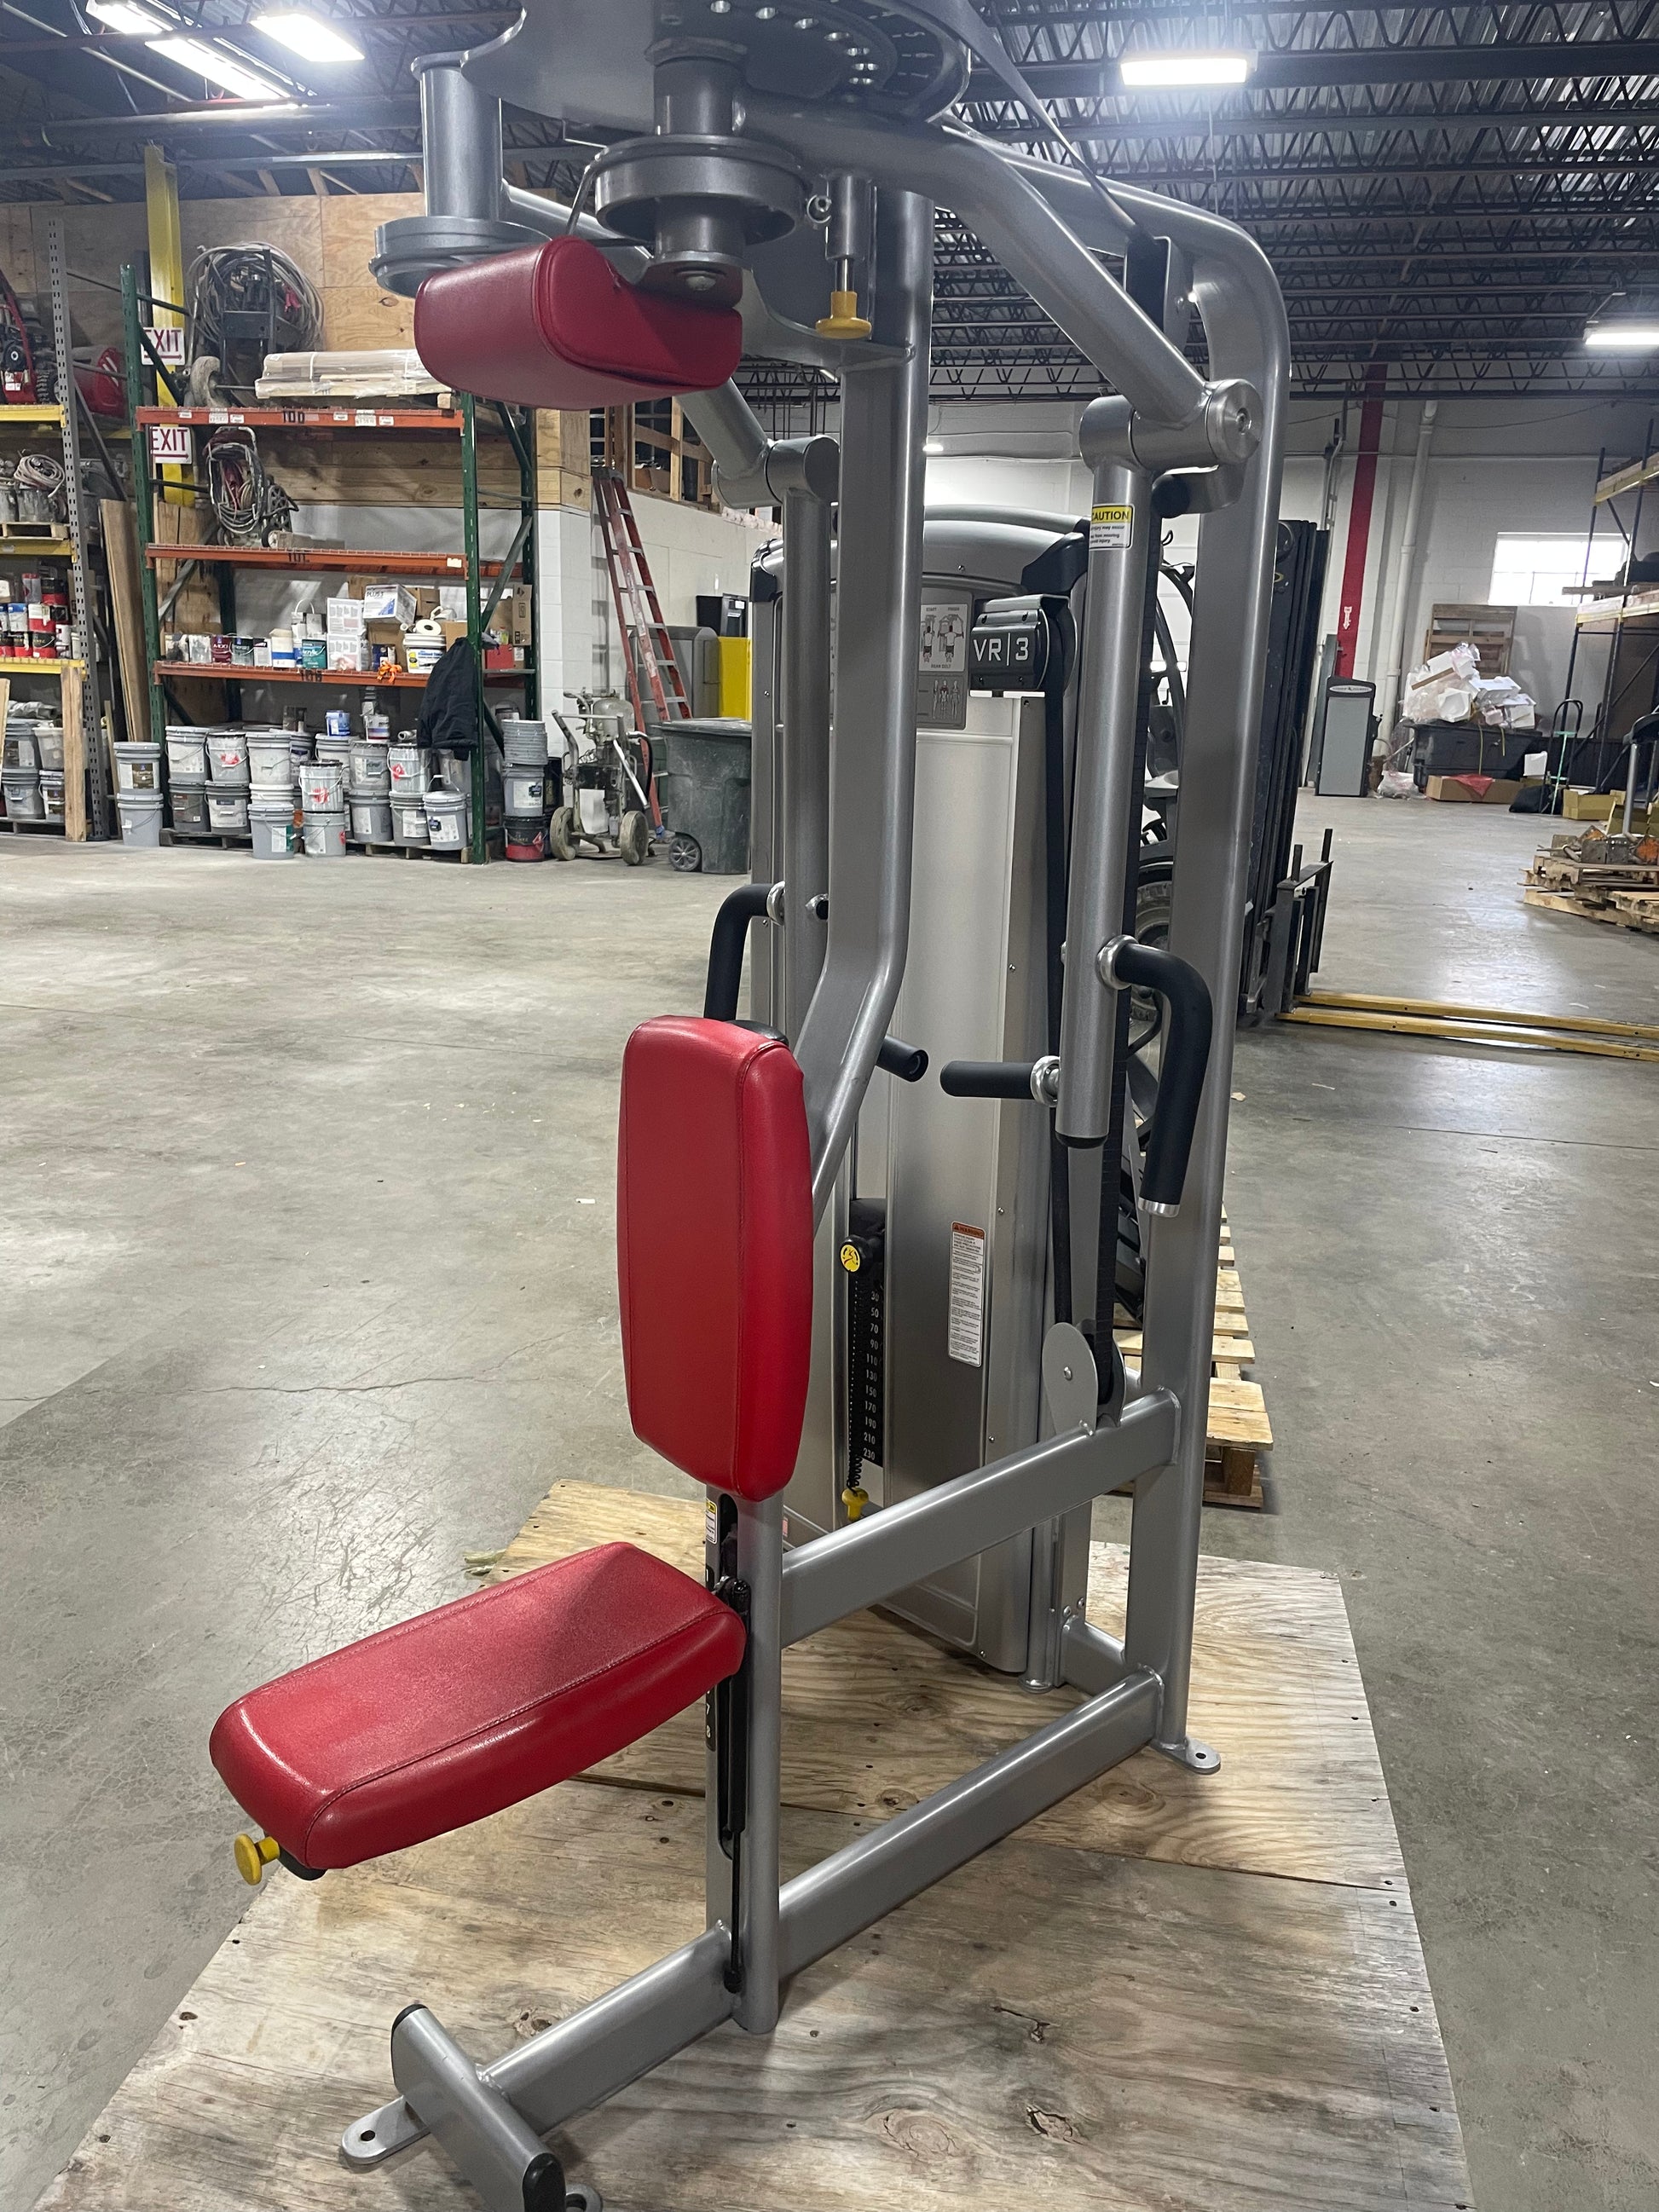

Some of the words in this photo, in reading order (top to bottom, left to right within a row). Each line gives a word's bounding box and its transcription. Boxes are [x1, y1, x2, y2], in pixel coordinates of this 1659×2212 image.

[151, 429, 188, 452] EXIT
[973, 638, 1003, 662] VR
[1015, 638, 1030, 661] 3
[870, 1308, 879, 1318] 50
[870, 1323, 878, 1334] 70
[870, 1339, 878, 1350] 90
[866, 1353, 878, 1366] 110
[866, 1369, 877, 1382] 130
[865, 1385, 877, 1398] 150
[864, 1401, 876, 1413] 170
[864, 1416, 876, 1429] 190
[864, 1432, 876, 1445] 210
[863, 1447, 876, 1461] 230
